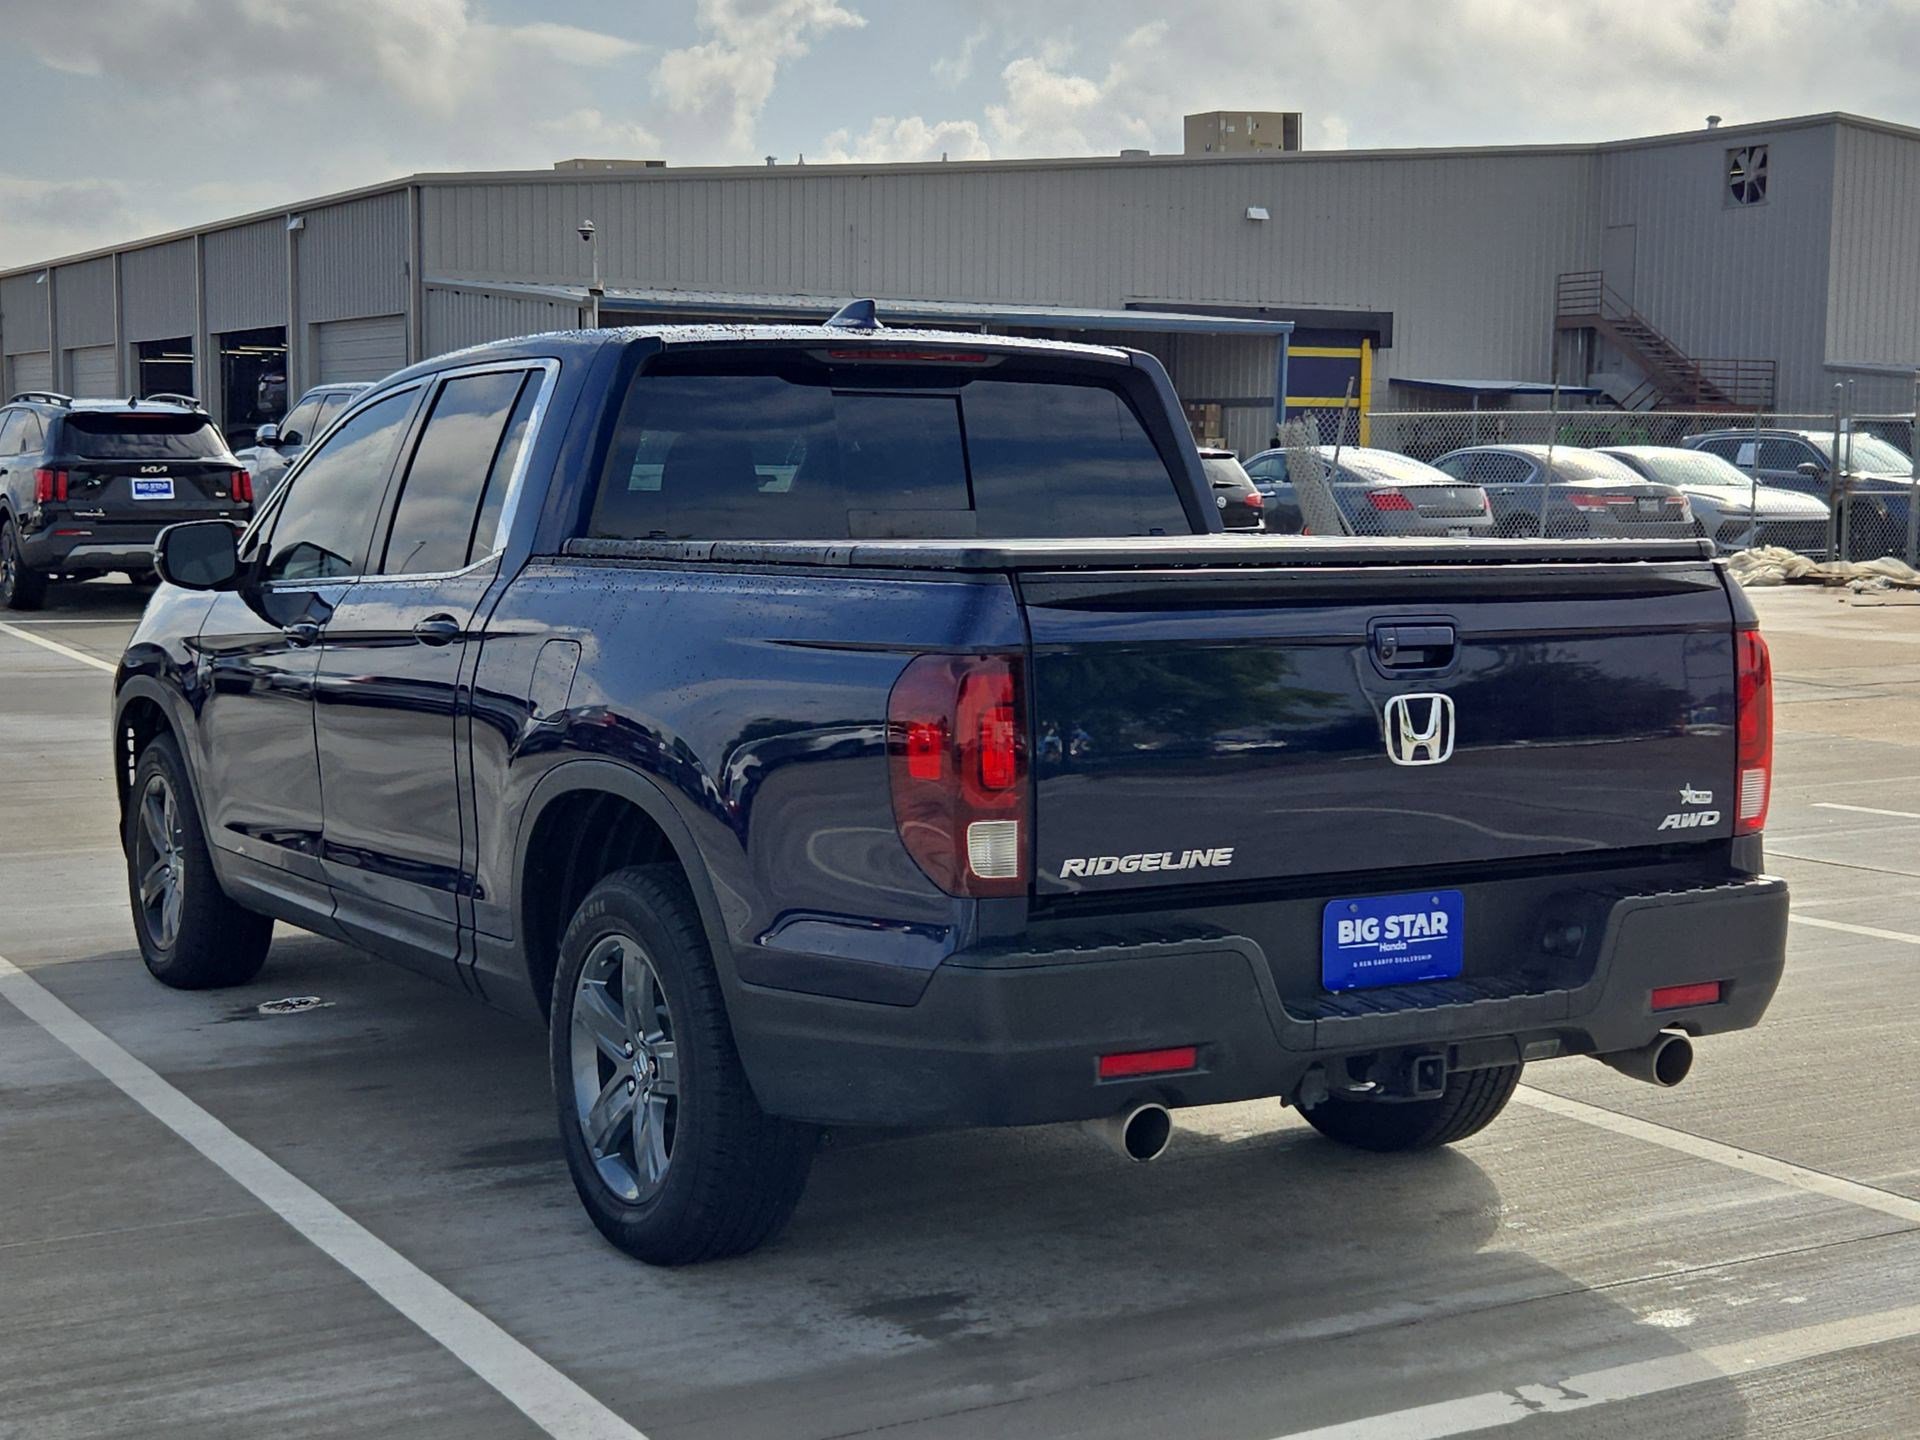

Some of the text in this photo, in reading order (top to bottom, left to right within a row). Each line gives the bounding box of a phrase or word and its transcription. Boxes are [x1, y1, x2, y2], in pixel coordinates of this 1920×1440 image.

[1657, 810, 1720, 831] AWD
[1059, 847, 1235, 879] RIDGELINE
[1338, 911, 1449, 944] BIG STAR
[1379, 940, 1407, 952] Honda
